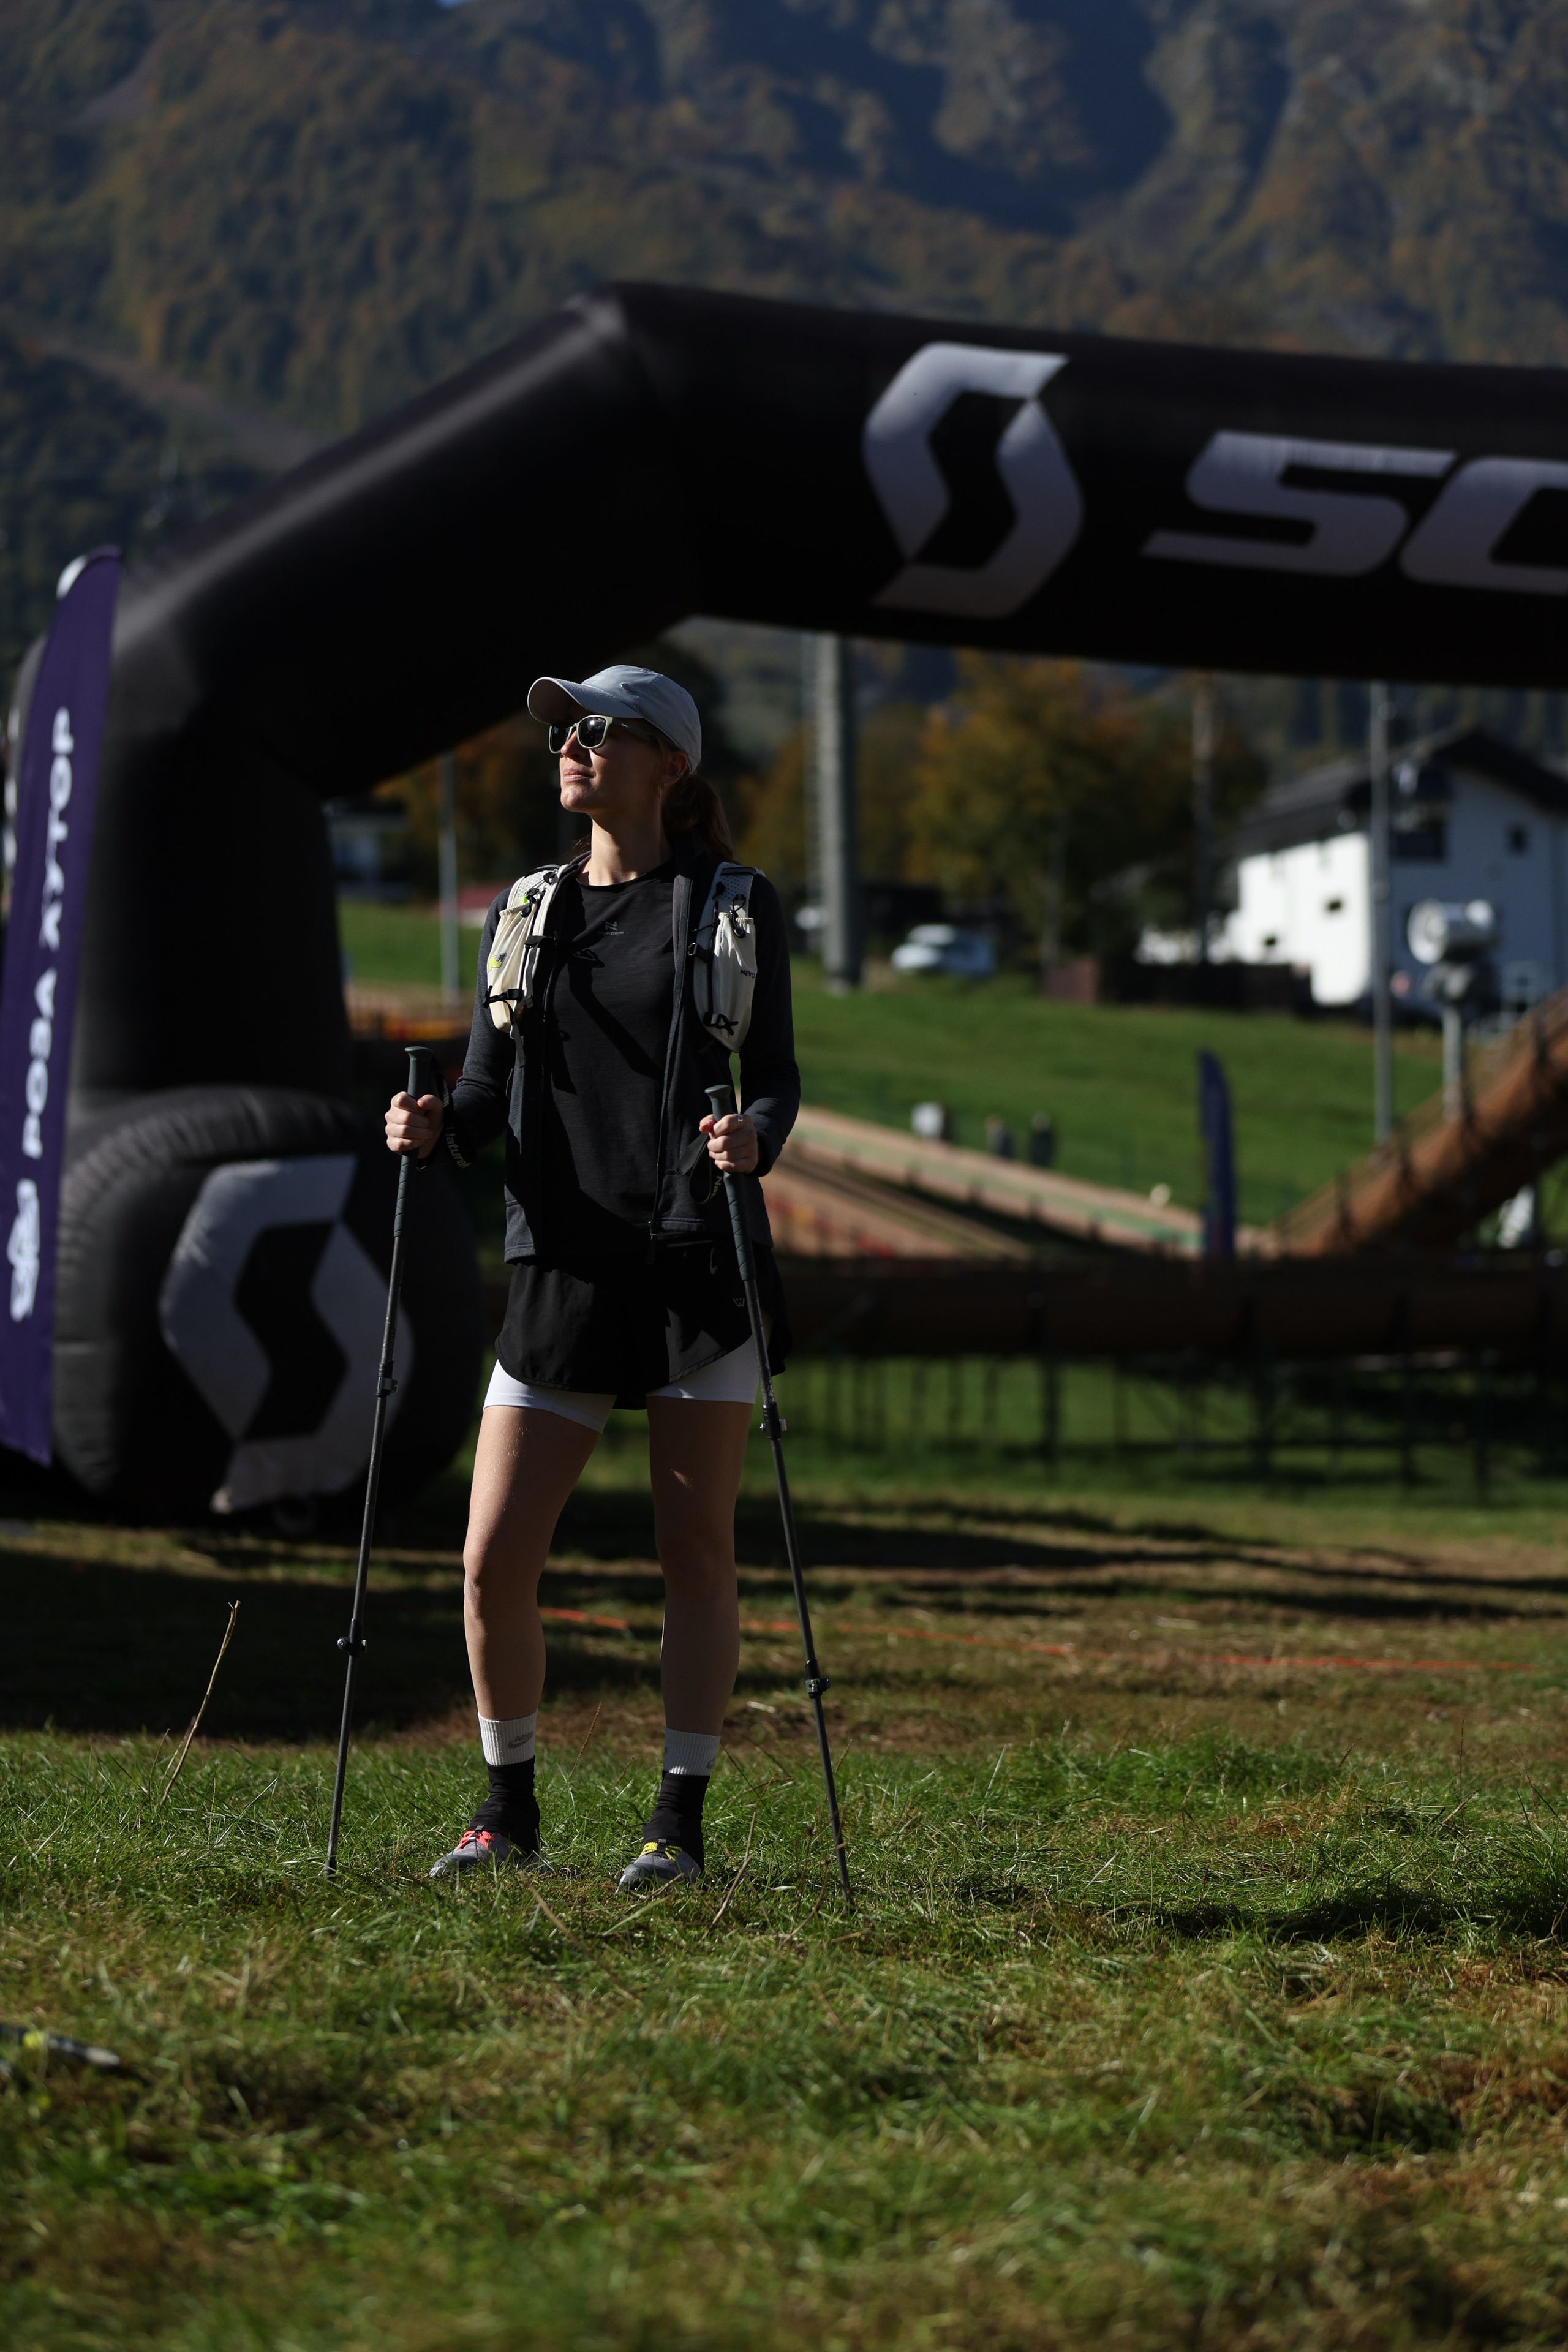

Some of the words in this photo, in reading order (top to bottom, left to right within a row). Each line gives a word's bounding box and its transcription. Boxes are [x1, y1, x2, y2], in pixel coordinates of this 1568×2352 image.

[39, 706, 75, 953] ХУТОР
[21, 967, 58, 1159] РОЗА
[740, 969, 755, 979] NEVO
